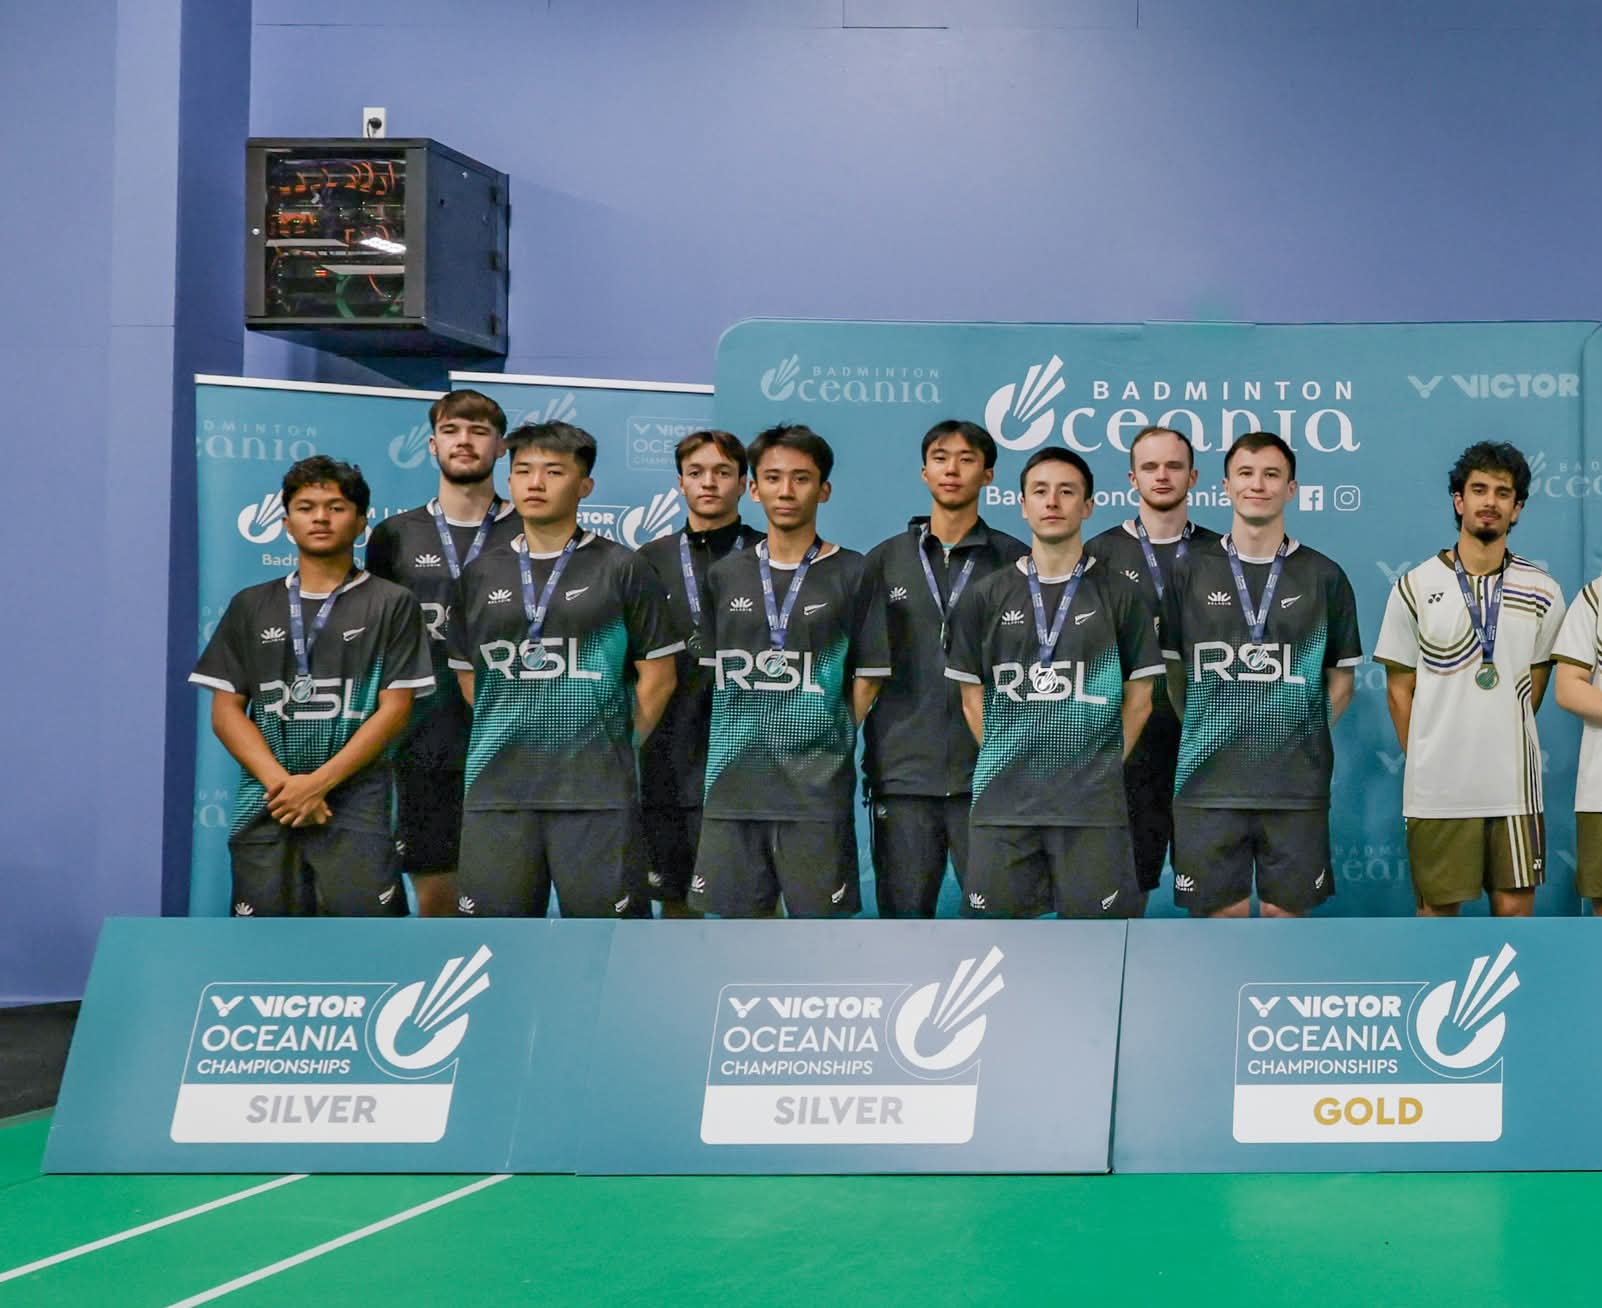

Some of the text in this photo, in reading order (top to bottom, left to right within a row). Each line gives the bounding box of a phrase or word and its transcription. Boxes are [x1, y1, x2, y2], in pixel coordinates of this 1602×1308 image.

[812, 367, 939, 379] BADMINTON
[1092, 380, 1353, 400] BADMINTON
[1451, 374, 1579, 398] VICTOR
[480, 637, 602, 680] RSL
[715, 648, 825, 694] RSL
[1193, 641, 1305, 684] RSL
[250, 995, 366, 1018] VICTOR
[767, 996, 883, 1019] VICTOR
[1286, 995, 1402, 1018] VICTOR
[201, 1024, 359, 1052] OCEANIA
[723, 1025, 879, 1053] OCEANIA
[1247, 1025, 1402, 1052] OCEANIA
[197, 1058, 351, 1075] CHAMPIONSHIPS
[720, 1060, 873, 1076] CHAMPIONSHIPS
[1247, 1059, 1398, 1075] CHAMPIONSHIPS
[246, 1095, 377, 1124] SILVER
[773, 1096, 904, 1125] SILVER
[1313, 1096, 1424, 1125] GOLD
